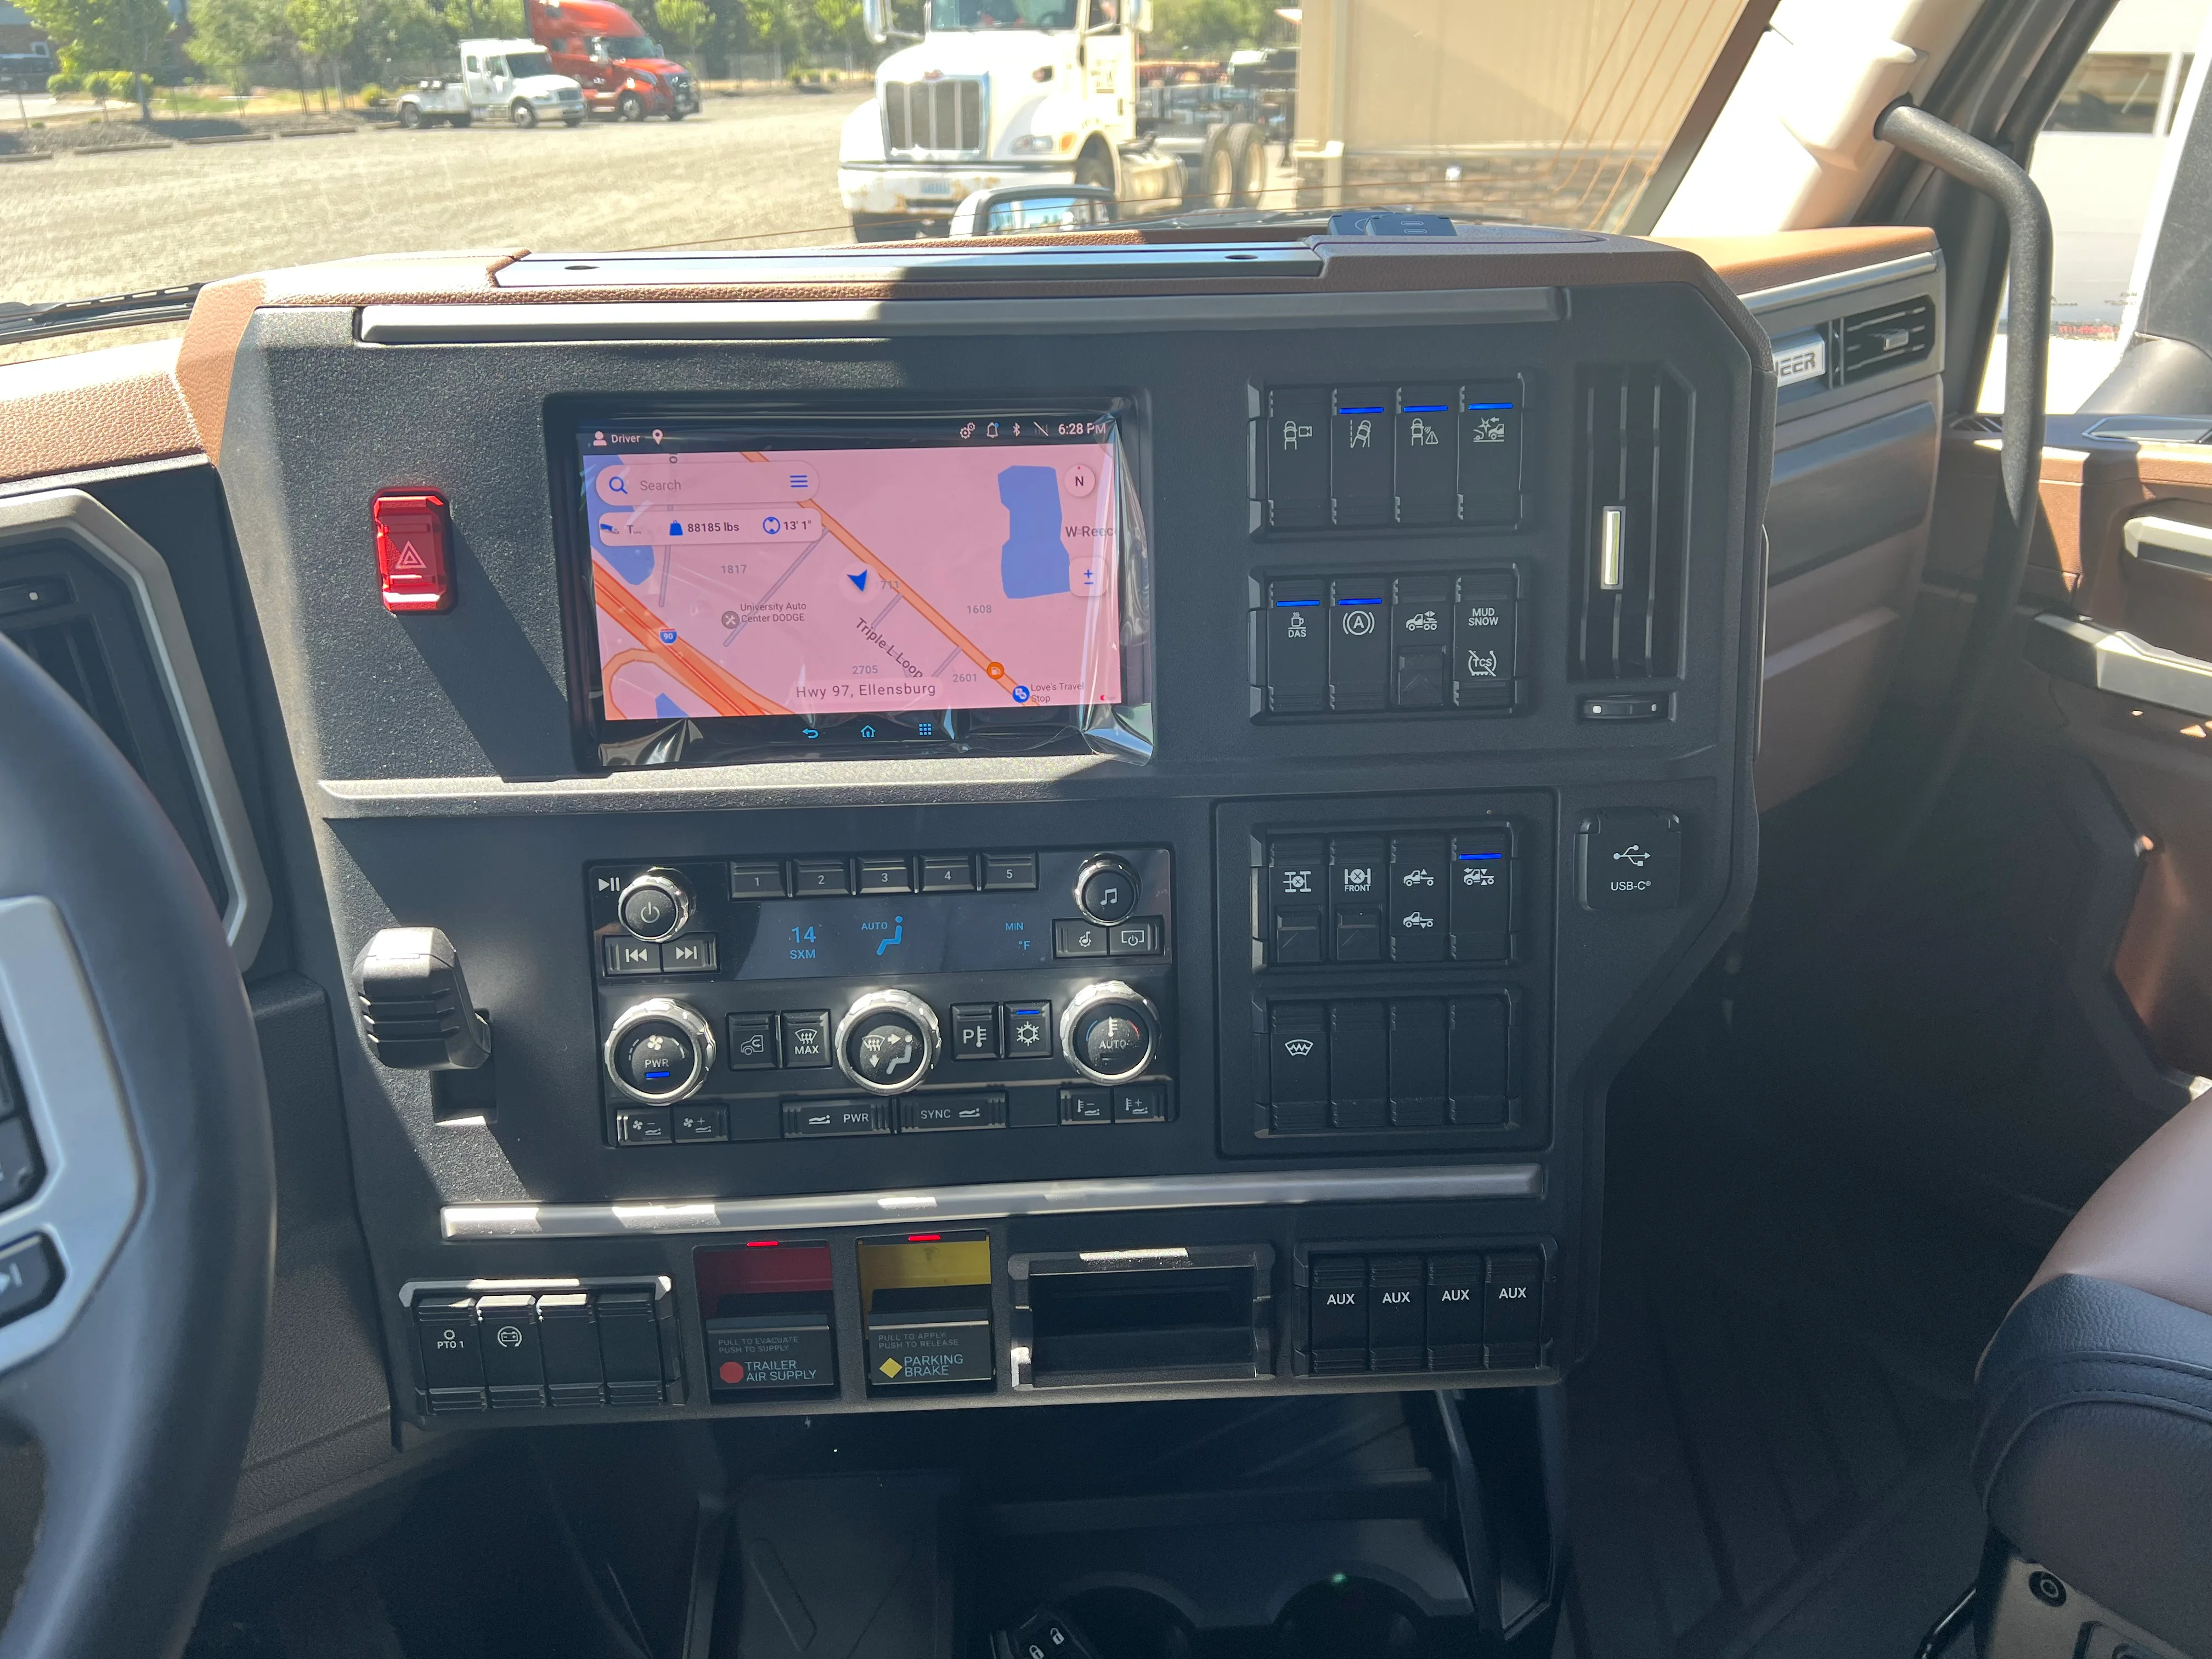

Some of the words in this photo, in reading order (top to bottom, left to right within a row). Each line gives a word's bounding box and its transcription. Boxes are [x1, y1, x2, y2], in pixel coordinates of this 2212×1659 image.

[1775, 351, 1815, 376] EER
[1058, 423, 1084, 435] 6:28
[1087, 423, 1106, 435] PM
[611, 434, 640, 443] Driver
[640, 479, 681, 491] Search
[1075, 476, 1084, 487] N
[687, 522, 721, 533] 88185
[724, 521, 740, 532] lbs
[1065, 526, 1077, 537] W
[721, 565, 747, 574] 1817
[880, 580, 899, 590] 711
[740, 602, 783, 613] University
[786, 601, 806, 611] Auto
[967, 604, 992, 614] 1608
[1472, 607, 1495, 617] MUD
[741, 613, 770, 623] Center
[772, 613, 805, 622] DODGE
[1468, 616, 1499, 627] SNOW
[663, 632, 674, 640] 90
[1288, 629, 1307, 638] DAS
[856, 617, 887, 649] Triple
[895, 652, 923, 678] Loop
[1473, 658, 1493, 668] TCS
[852, 665, 878, 675] 2705
[953, 673, 978, 682] 2601
[796, 686, 827, 700] Hwy
[832, 685, 854, 698] 97,
[859, 682, 936, 697] Ellensburg
[1031, 682, 1057, 692] Love's
[1059, 681, 1084, 691] Travel
[1031, 694, 1051, 703] Stop
[881, 872, 888, 883] 3
[944, 871, 952, 881] 4
[1006, 868, 1013, 879] 5
[754, 877, 760, 887] 1
[817, 874, 825, 885] 2
[1344, 884, 1371, 892] FRONT
[861, 922, 888, 930] AUTO
[1005, 921, 1024, 931] MIN
[792, 926, 816, 944] 14
[789, 949, 816, 960] SXM
[1098, 1039, 1126, 1049] AUTO
[794, 1045, 819, 1055] MAX
[645, 1058, 669, 1069] PWR
[843, 1113, 870, 1124] PWR
[920, 1108, 951, 1120] SYNC
[1382, 1291, 1410, 1304] AUX
[1441, 1289, 1470, 1301] AUX
[1498, 1286, 1527, 1299] AUX
[1327, 1293, 1355, 1305] AUX
[755, 1335, 799, 1345] EVACUATE
[878, 1334, 901, 1342] PULL
[916, 1331, 945, 1340] APPLY
[437, 1341, 457, 1350] PTO
[459, 1340, 465, 1348] 1
[920, 1339, 959, 1347] RELEASE
[719, 1346, 741, 1354] PUSH
[757, 1344, 789, 1352] SUPPLY
[904, 1353, 963, 1366] PARKING
[744, 1359, 798, 1372] TRAILER
[746, 1371, 766, 1382] AIR
[769, 1369, 816, 1381] SUPPLY
[904, 1365, 950, 1378] BRAKE
